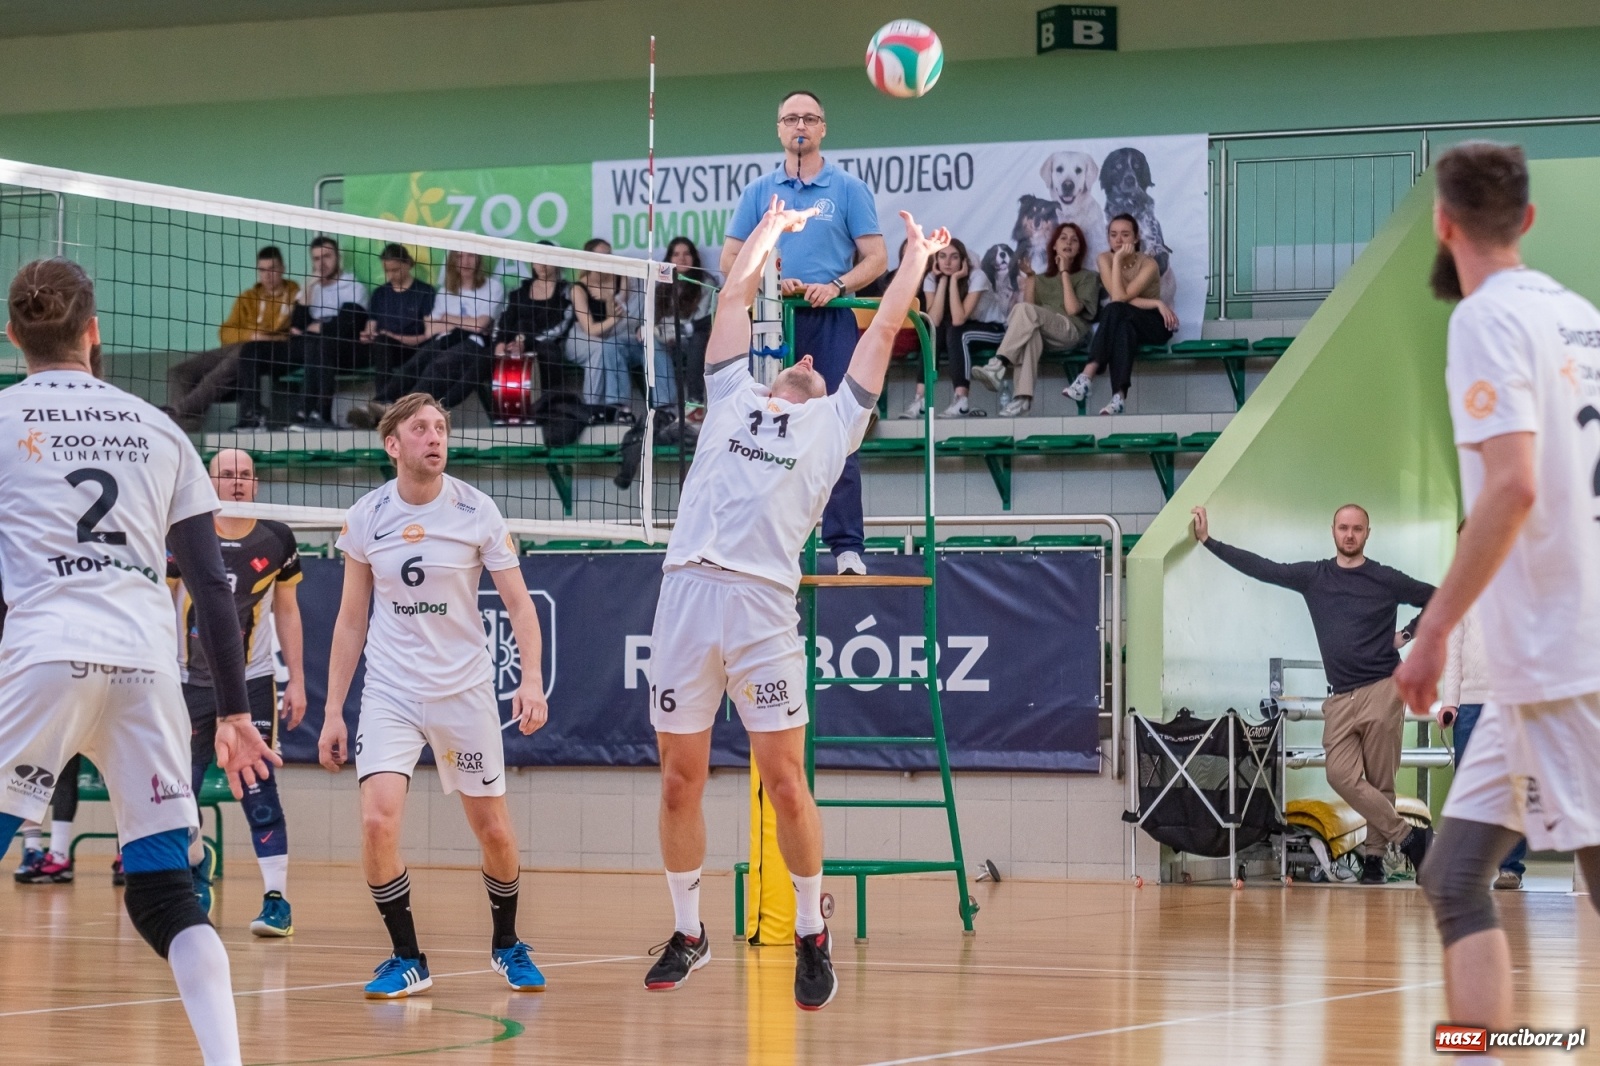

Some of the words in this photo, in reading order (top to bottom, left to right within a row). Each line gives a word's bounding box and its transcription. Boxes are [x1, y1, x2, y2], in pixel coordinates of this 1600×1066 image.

[1071, 8, 1106, 16] SEKTOR
[1041, 22, 1055, 48] B
[1073, 19, 1104, 45] B
[611, 162, 762, 206] WSZYSTKO
[446, 191, 569, 238] ZOO
[612, 208, 735, 251] DOMOW
[22, 407, 141, 423] ZIELIŃSKI
[748, 409, 791, 438] 11
[50, 435, 149, 450] ZOO-MAR
[728, 438, 797, 470] TropiDog
[52, 450, 150, 463] LUNATYCY
[64, 467, 127, 546] 2
[400, 555, 426, 587] 6
[392, 600, 448, 617] TropiDog
[651, 684, 677, 713] 16
[755, 679, 787, 695] ZOO
[756, 690, 789, 705] MAR
[456, 751, 483, 762] ZOO
[456, 760, 484, 770] MAR
